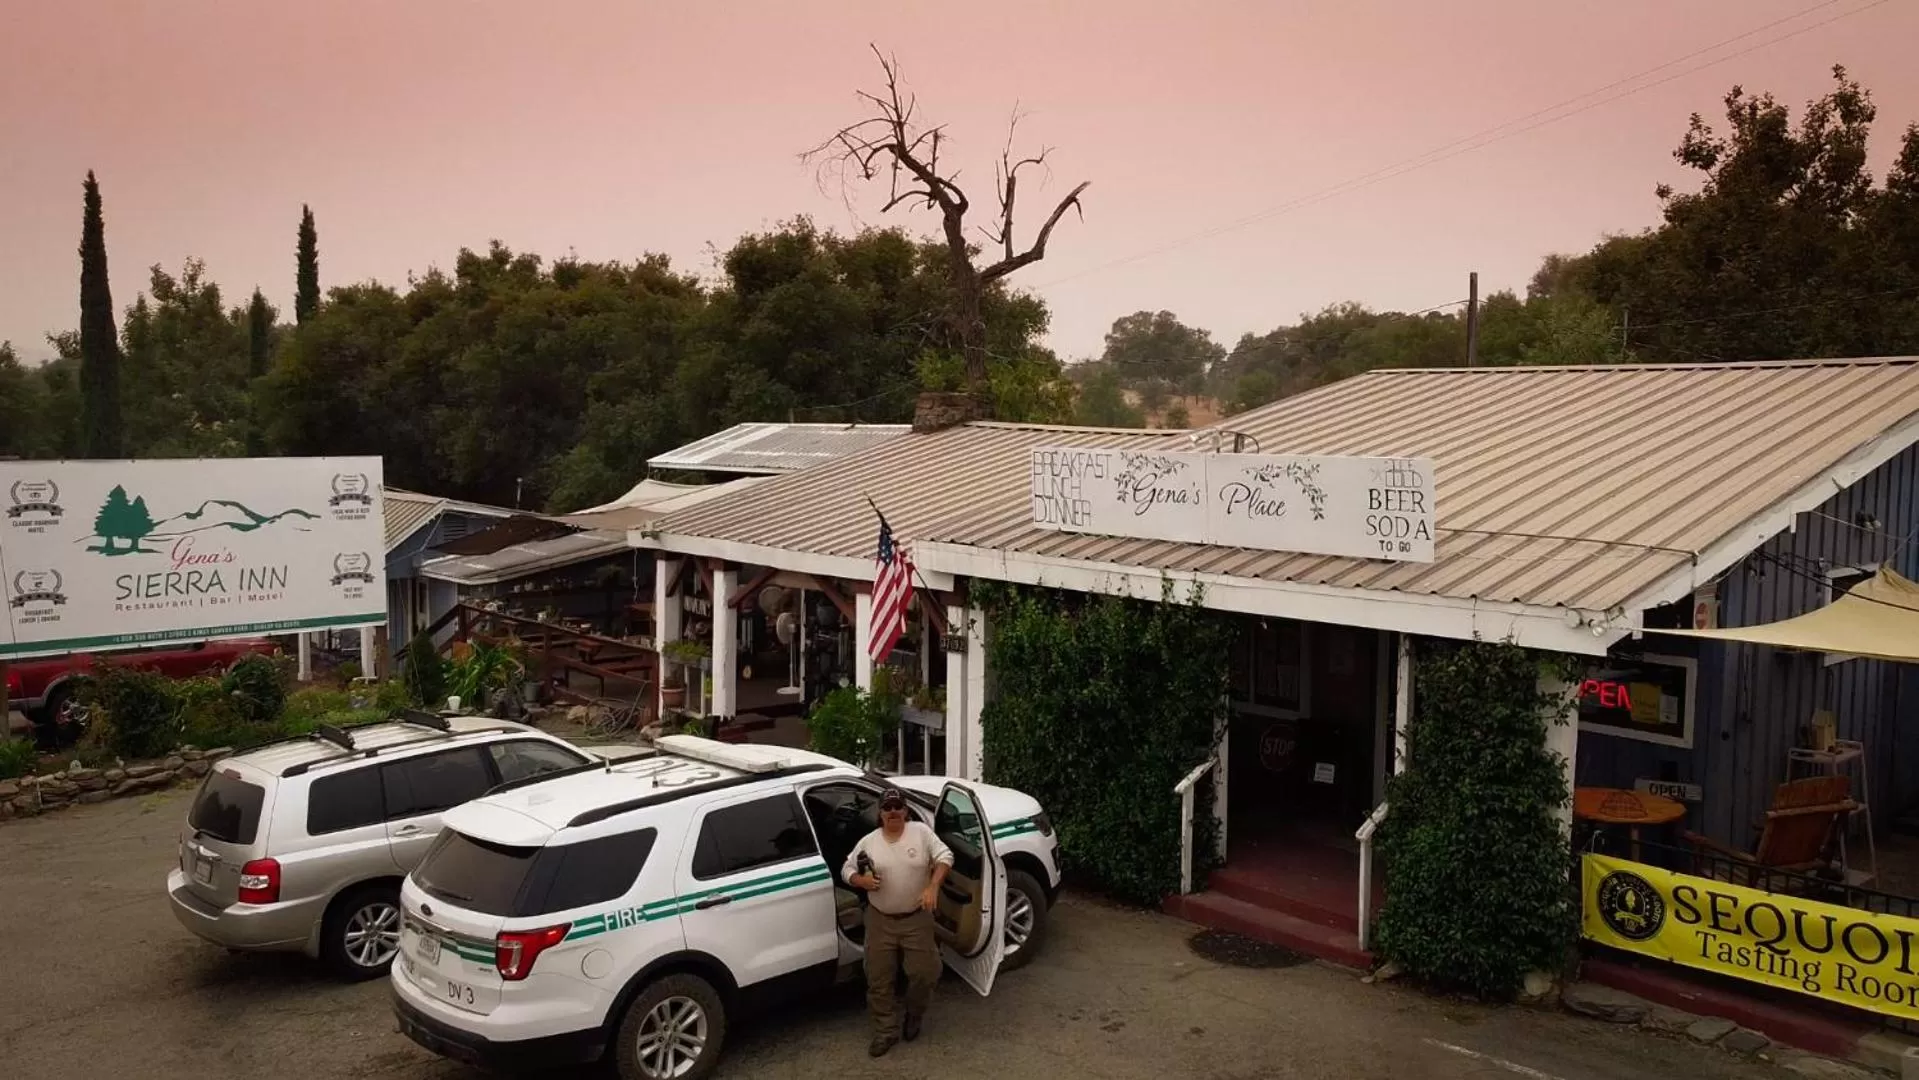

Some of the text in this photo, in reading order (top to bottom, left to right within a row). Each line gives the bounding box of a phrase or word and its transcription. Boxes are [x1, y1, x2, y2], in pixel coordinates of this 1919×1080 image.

[1033, 451, 1112, 479] BREAKFAST
[1132, 472, 1287, 519] Gena's Place
[1368, 488, 1427, 513] BEER
[1034, 494, 1092, 527] DINNER
[1366, 514, 1431, 541] SODA
[171, 535, 237, 570] Gena's
[1379, 540, 1411, 553] TO GO
[115, 565, 288, 600] SIERRA INN
[115, 591, 283, 611] Restaurant Bar Motel
[1263, 736, 1297, 757] STOP
[603, 906, 647, 931] FIRE
[1672, 884, 1919, 976] SEQUOI
[1695, 930, 1822, 993] Tasting
[447, 981, 475, 1004] DV 3
